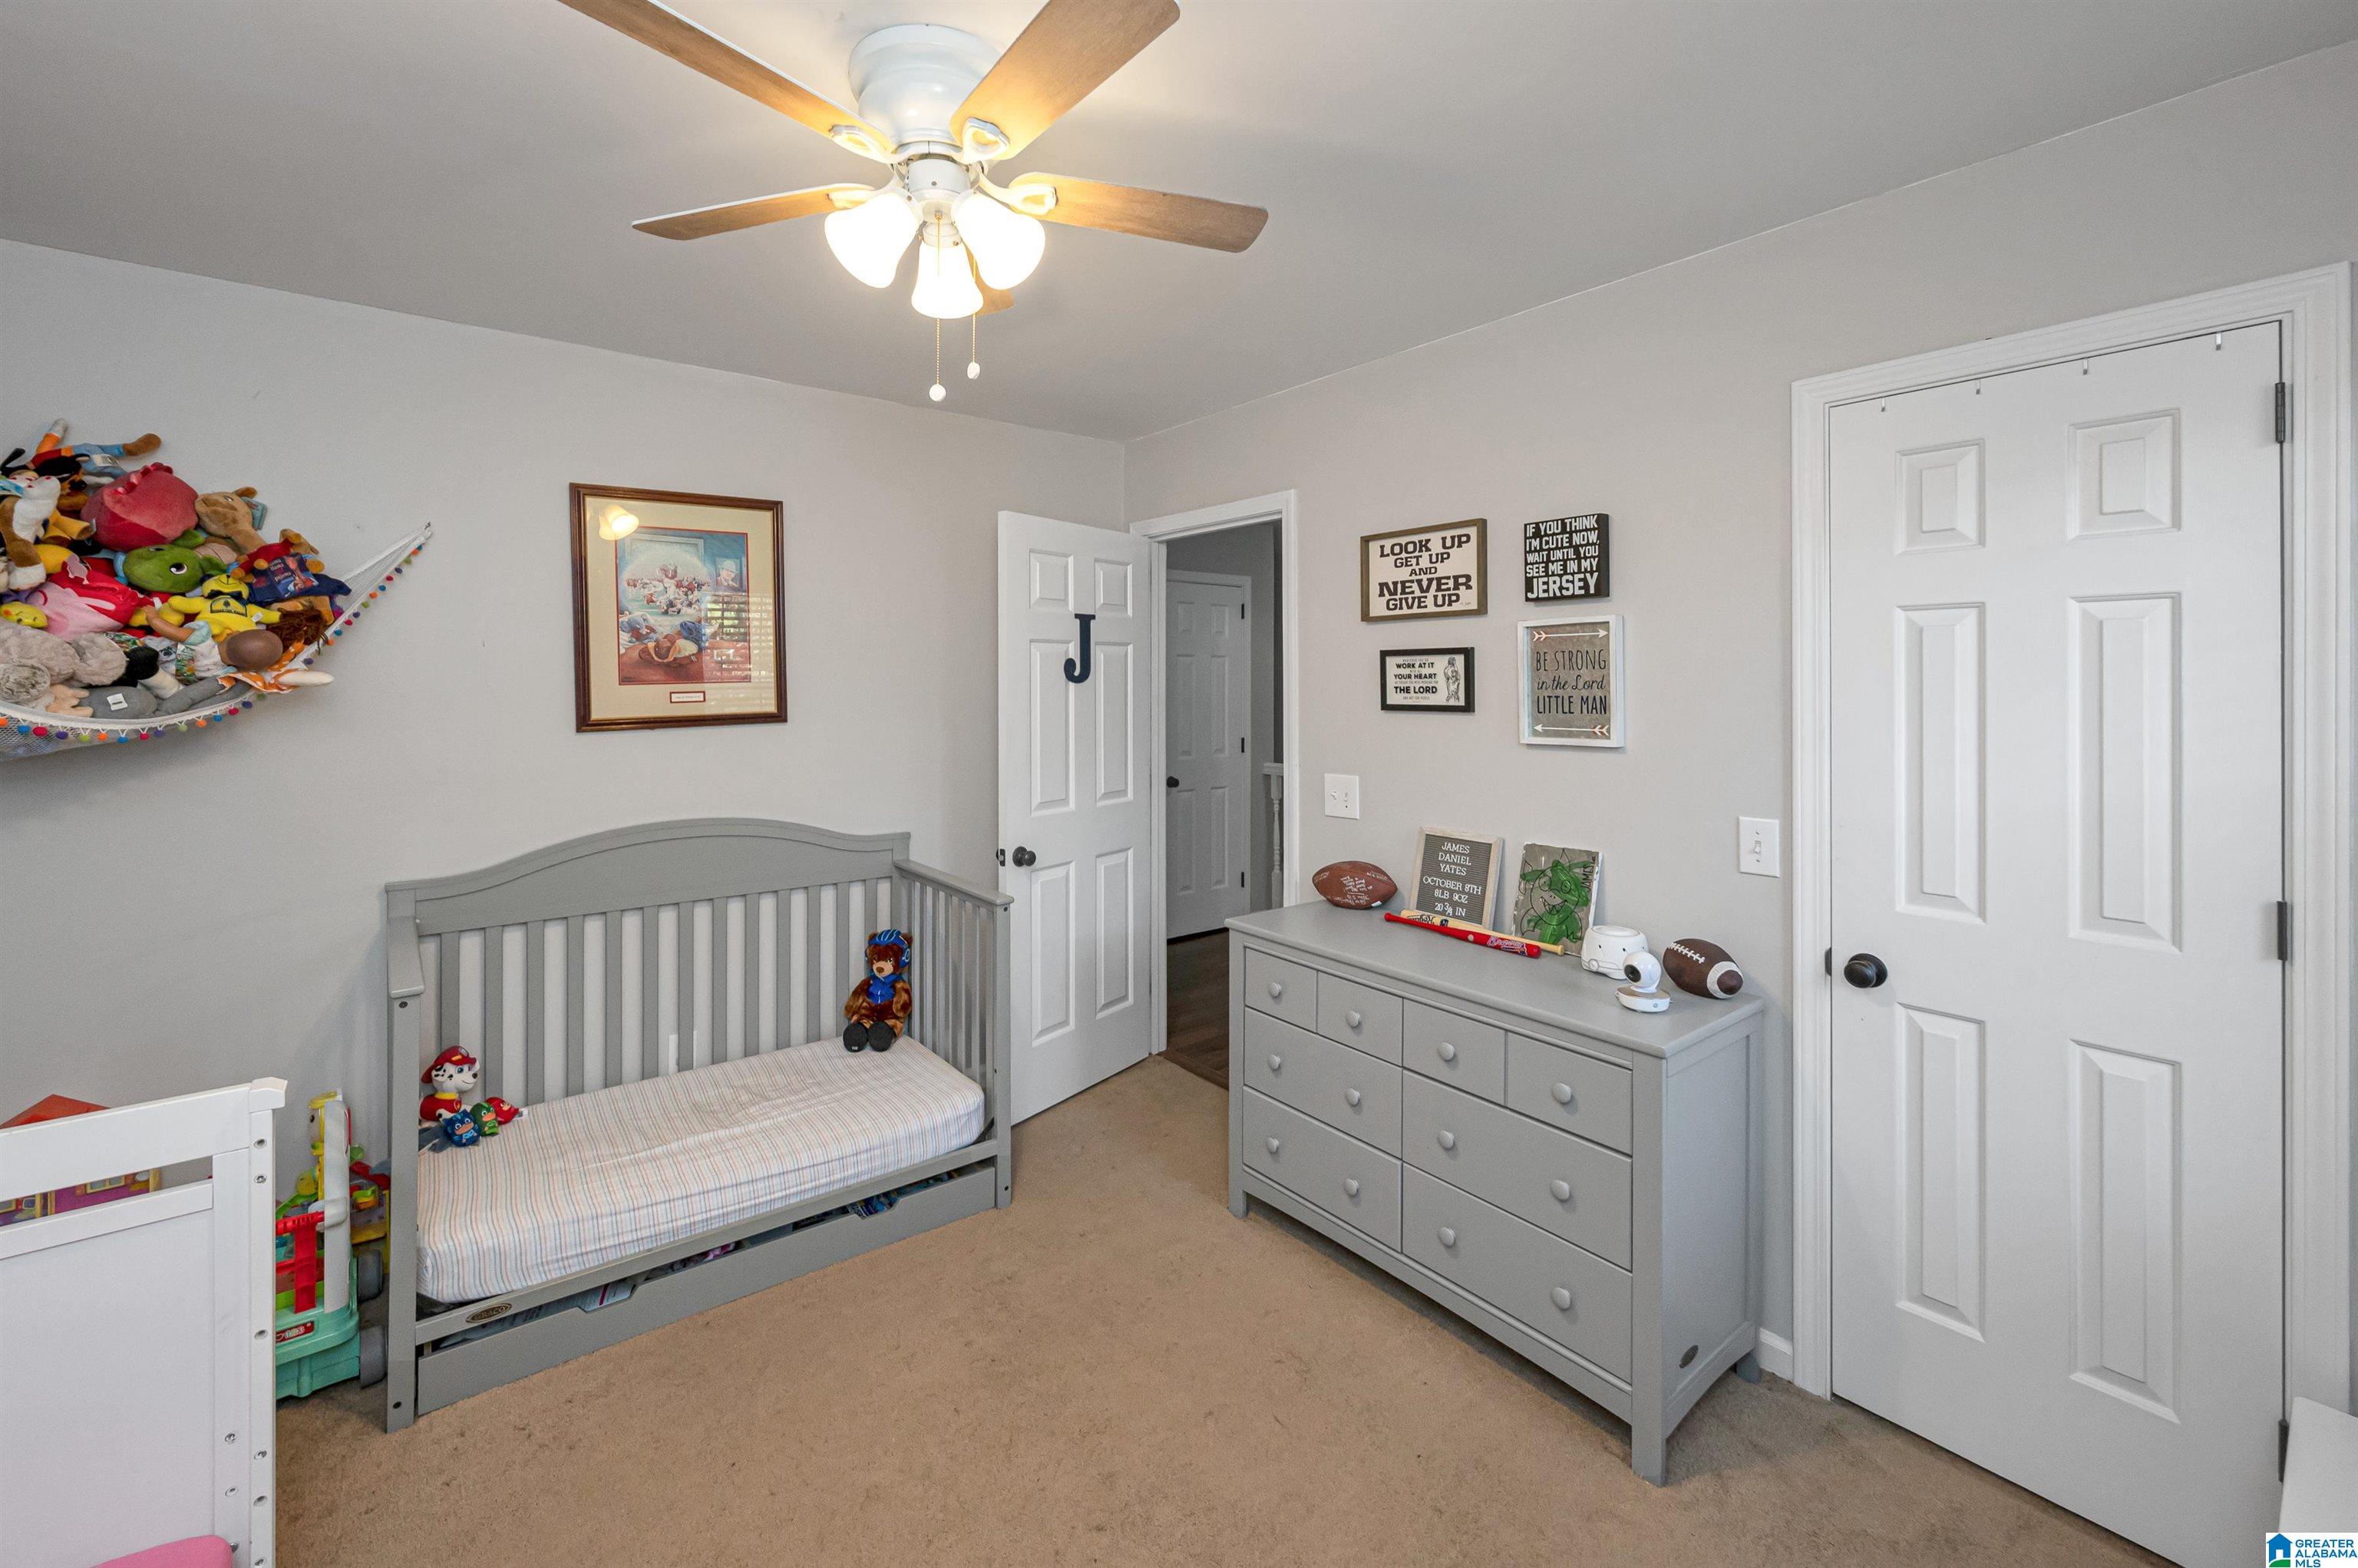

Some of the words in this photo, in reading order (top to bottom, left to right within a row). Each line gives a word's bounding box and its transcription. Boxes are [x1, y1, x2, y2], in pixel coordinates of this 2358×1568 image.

[1526, 523, 1535, 537] IF
[1539, 520, 1561, 535] YOU
[1564, 515, 1598, 531] THINK
[1379, 538, 1432, 558] LOOK
[1442, 533, 1471, 550] UP
[1526, 538, 1540, 551] I'M
[1542, 534, 1569, 550] CUTE
[1572, 530, 1600, 545] NOW,
[1394, 556, 1422, 568] GET
[1428, 552, 1451, 564] UP
[1526, 551, 1547, 563] WAIT
[1551, 548, 1576, 560] UNTIL
[1579, 545, 1598, 557] YOU
[1409, 566, 1438, 576] AND
[1526, 563, 1546, 577] SEE
[1549, 561, 1564, 575] ME
[1567, 560, 1578, 573] IN
[1581, 558, 1598, 572] MY
[1378, 574, 1473, 597] NEVER
[1527, 573, 1598, 599] JERSEY
[1386, 596, 1428, 611] GIVE
[1433, 593, 1460, 608] UP
[1064, 613, 1095, 683] J
[1536, 652, 1548, 672] BE
[1554, 649, 1606, 671] STRONG
[1537, 678, 1551, 690] in
[1551, 675, 1569, 690] the
[1571, 675, 1606, 691] Lord
[1537, 695, 1574, 714] LITTLE
[1580, 695, 1607, 715] MAN
[1442, 842, 1470, 853] JAMES
[1438, 853, 1471, 866] DANIEL
[1440, 863, 1466, 875] YATES
[1423, 876, 1462, 890] OCTOBER
[1465, 883, 1481, 895] 8TH
[1581, 865, 1594, 892] JAMES
[1435, 889, 1449, 899] 8LB
[1435, 903, 1443, 912] 20
[1455, 907, 1466, 916] IN
